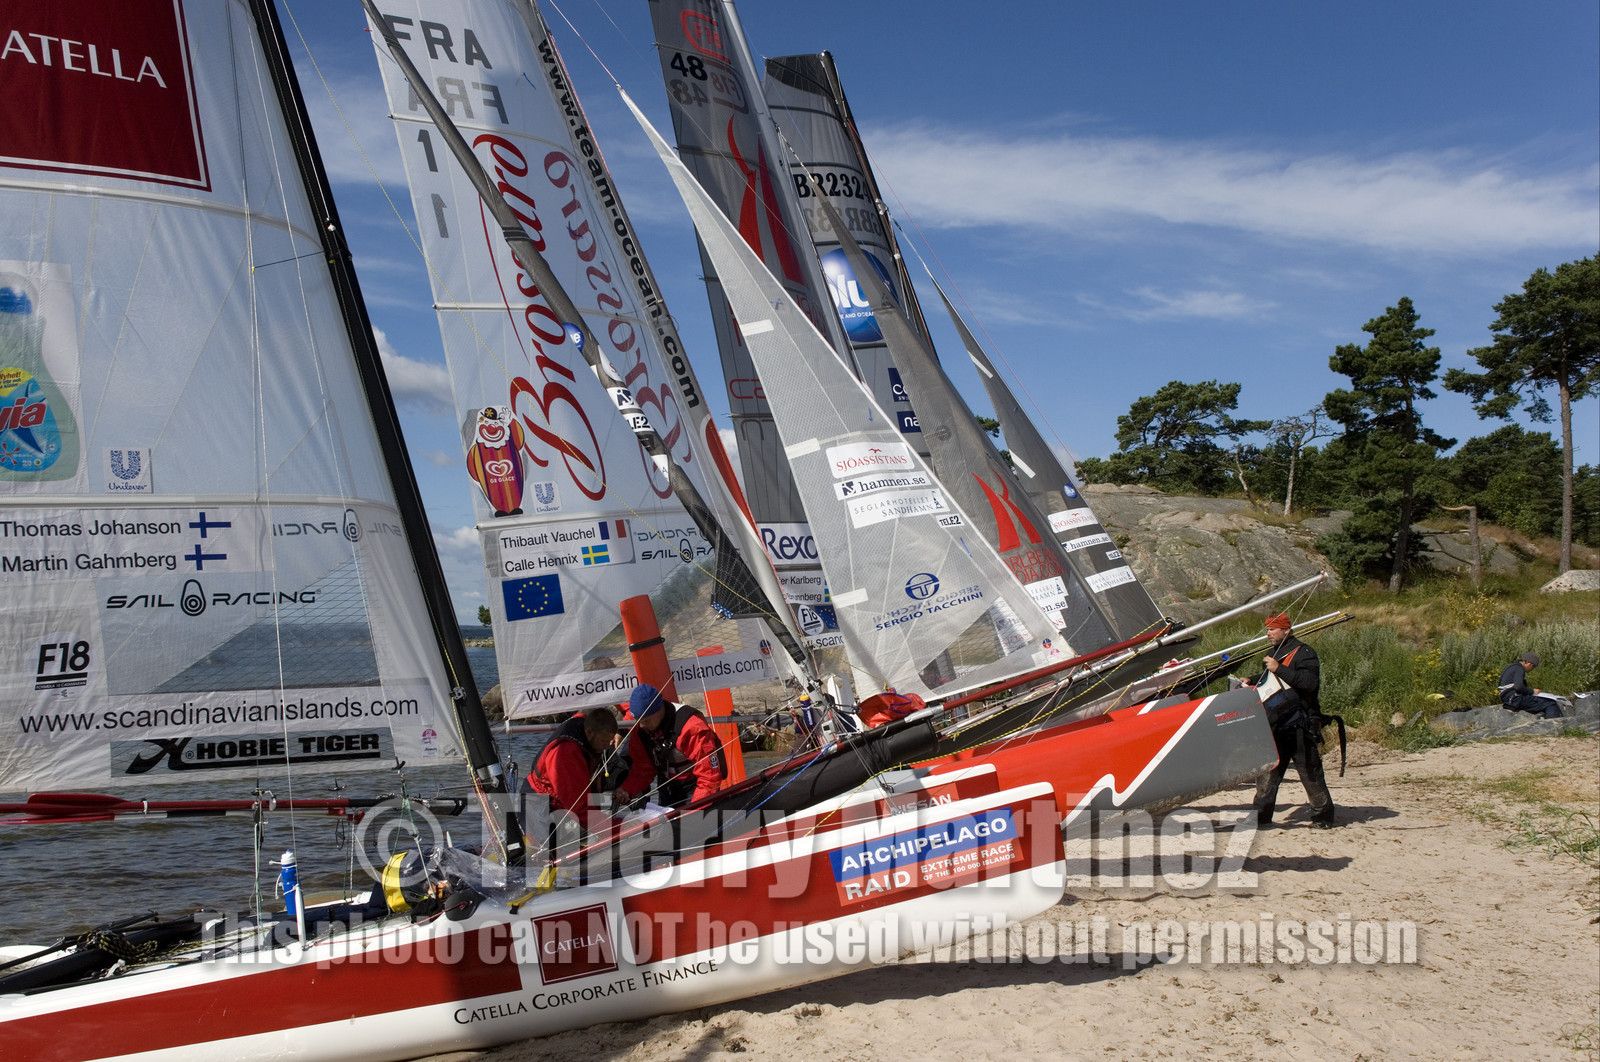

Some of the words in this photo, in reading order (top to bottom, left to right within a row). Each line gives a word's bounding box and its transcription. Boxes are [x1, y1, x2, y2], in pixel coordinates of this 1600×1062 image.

[383, 13, 493, 70] FRA
[693, 22, 722, 49] F18
[670, 52, 708, 81] 48
[836, 455, 908, 473] SJÖASSISTANS
[108, 481, 147, 491] Unilever
[858, 475, 926, 492] hamnen.se
[854, 496, 930, 515] SEGLARHOTELLET
[881, 504, 934, 518] SANDHAMN
[0, 520, 83, 538] Thomas
[88, 519, 182, 536] Johanson
[939, 515, 962, 527] TELE2
[500, 533, 549, 549] Thibault
[550, 527, 596, 543] Vauchel
[1070, 535, 1110, 551] hamnen.se
[2, 555, 69, 573] Martin
[75, 552, 177, 571] Gahmberg
[504, 559, 535, 573] Calle
[537, 553, 579, 568] Hennix
[641, 549, 678, 561] SAIL
[790, 575, 822, 586] Karlberg
[106, 594, 175, 609] SAIL
[212, 591, 317, 607] RACING
[876, 611, 924, 632] SERGIO
[926, 591, 984, 614] TACCHINI
[37, 640, 91, 675] F18
[20, 697, 419, 734] www.scandinavianislands.com
[196, 738, 286, 760] HOBIE
[298, 733, 380, 754] TIGER
[841, 817, 1008, 873] ARCHIPELAGO
[920, 851, 979, 874] EXTREME
[981, 842, 1014, 859] RACE
[923, 874, 934, 882] OF
[935, 869, 951, 879] THE
[953, 865, 966, 875] 100
[967, 861, 981, 871] 000
[982, 852, 1016, 867] ISLANDS
[844, 870, 911, 901] RAID
[543, 932, 606, 955] CATELLA
[453, 1000, 529, 1025] CATELLA
[532, 977, 637, 1011] CORPORATE
[641, 958, 719, 990] FINANCE
